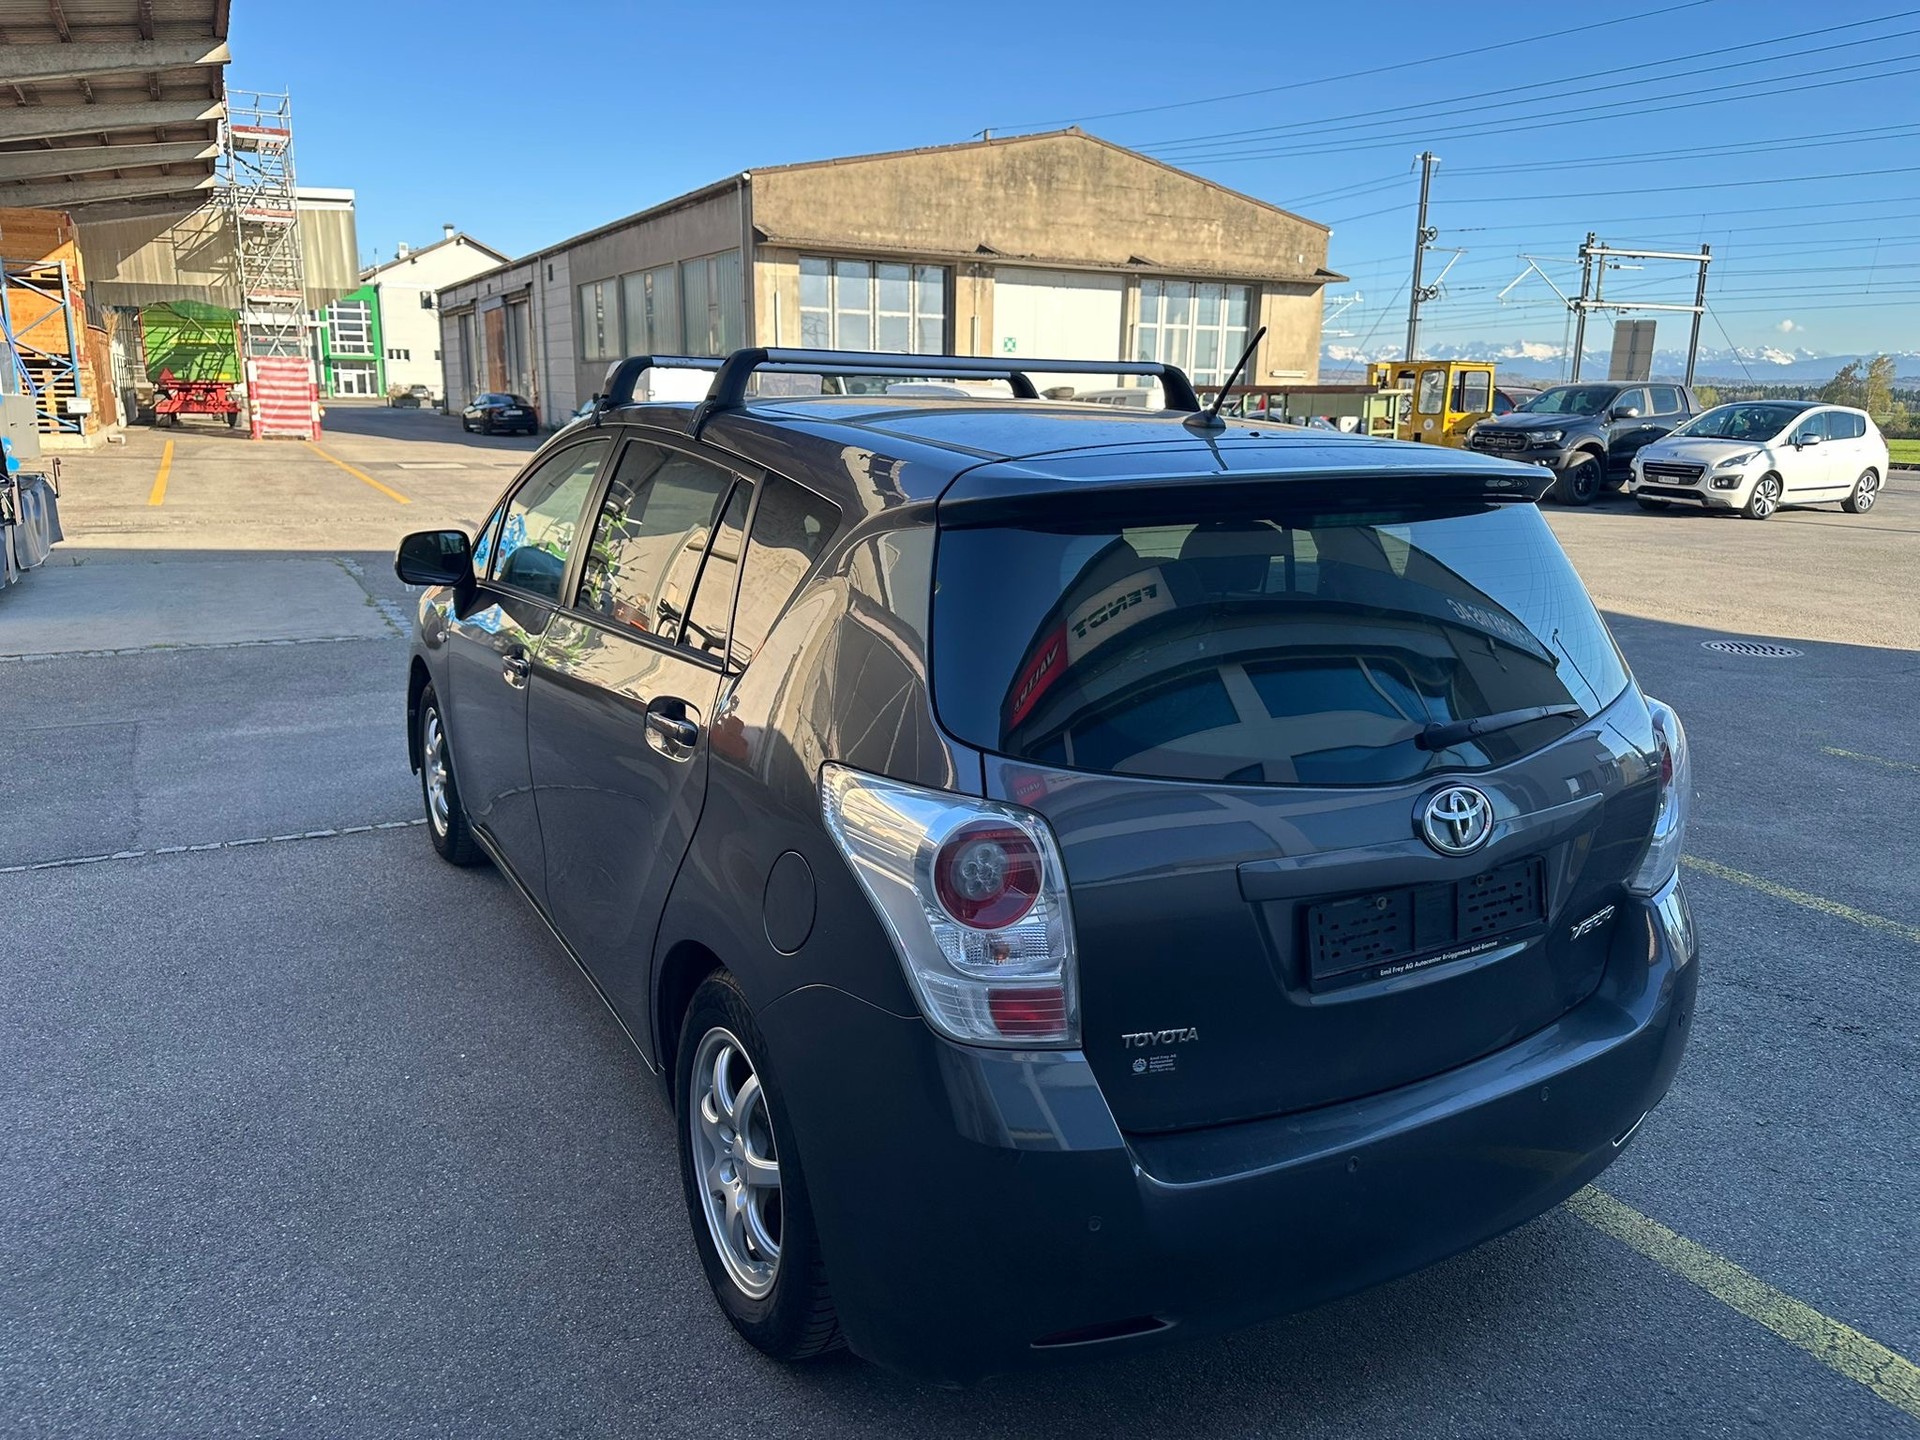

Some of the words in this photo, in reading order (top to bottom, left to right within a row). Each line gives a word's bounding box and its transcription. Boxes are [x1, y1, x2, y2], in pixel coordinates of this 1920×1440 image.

[1474, 436, 1521, 447] FORD
[1379, 967, 1392, 976] Emil
[1392, 965, 1404, 975] Frey
[1404, 962, 1414, 970] AG
[1414, 955, 1442, 967] Autocenter
[1121, 1026, 1199, 1049] TOYOTA
